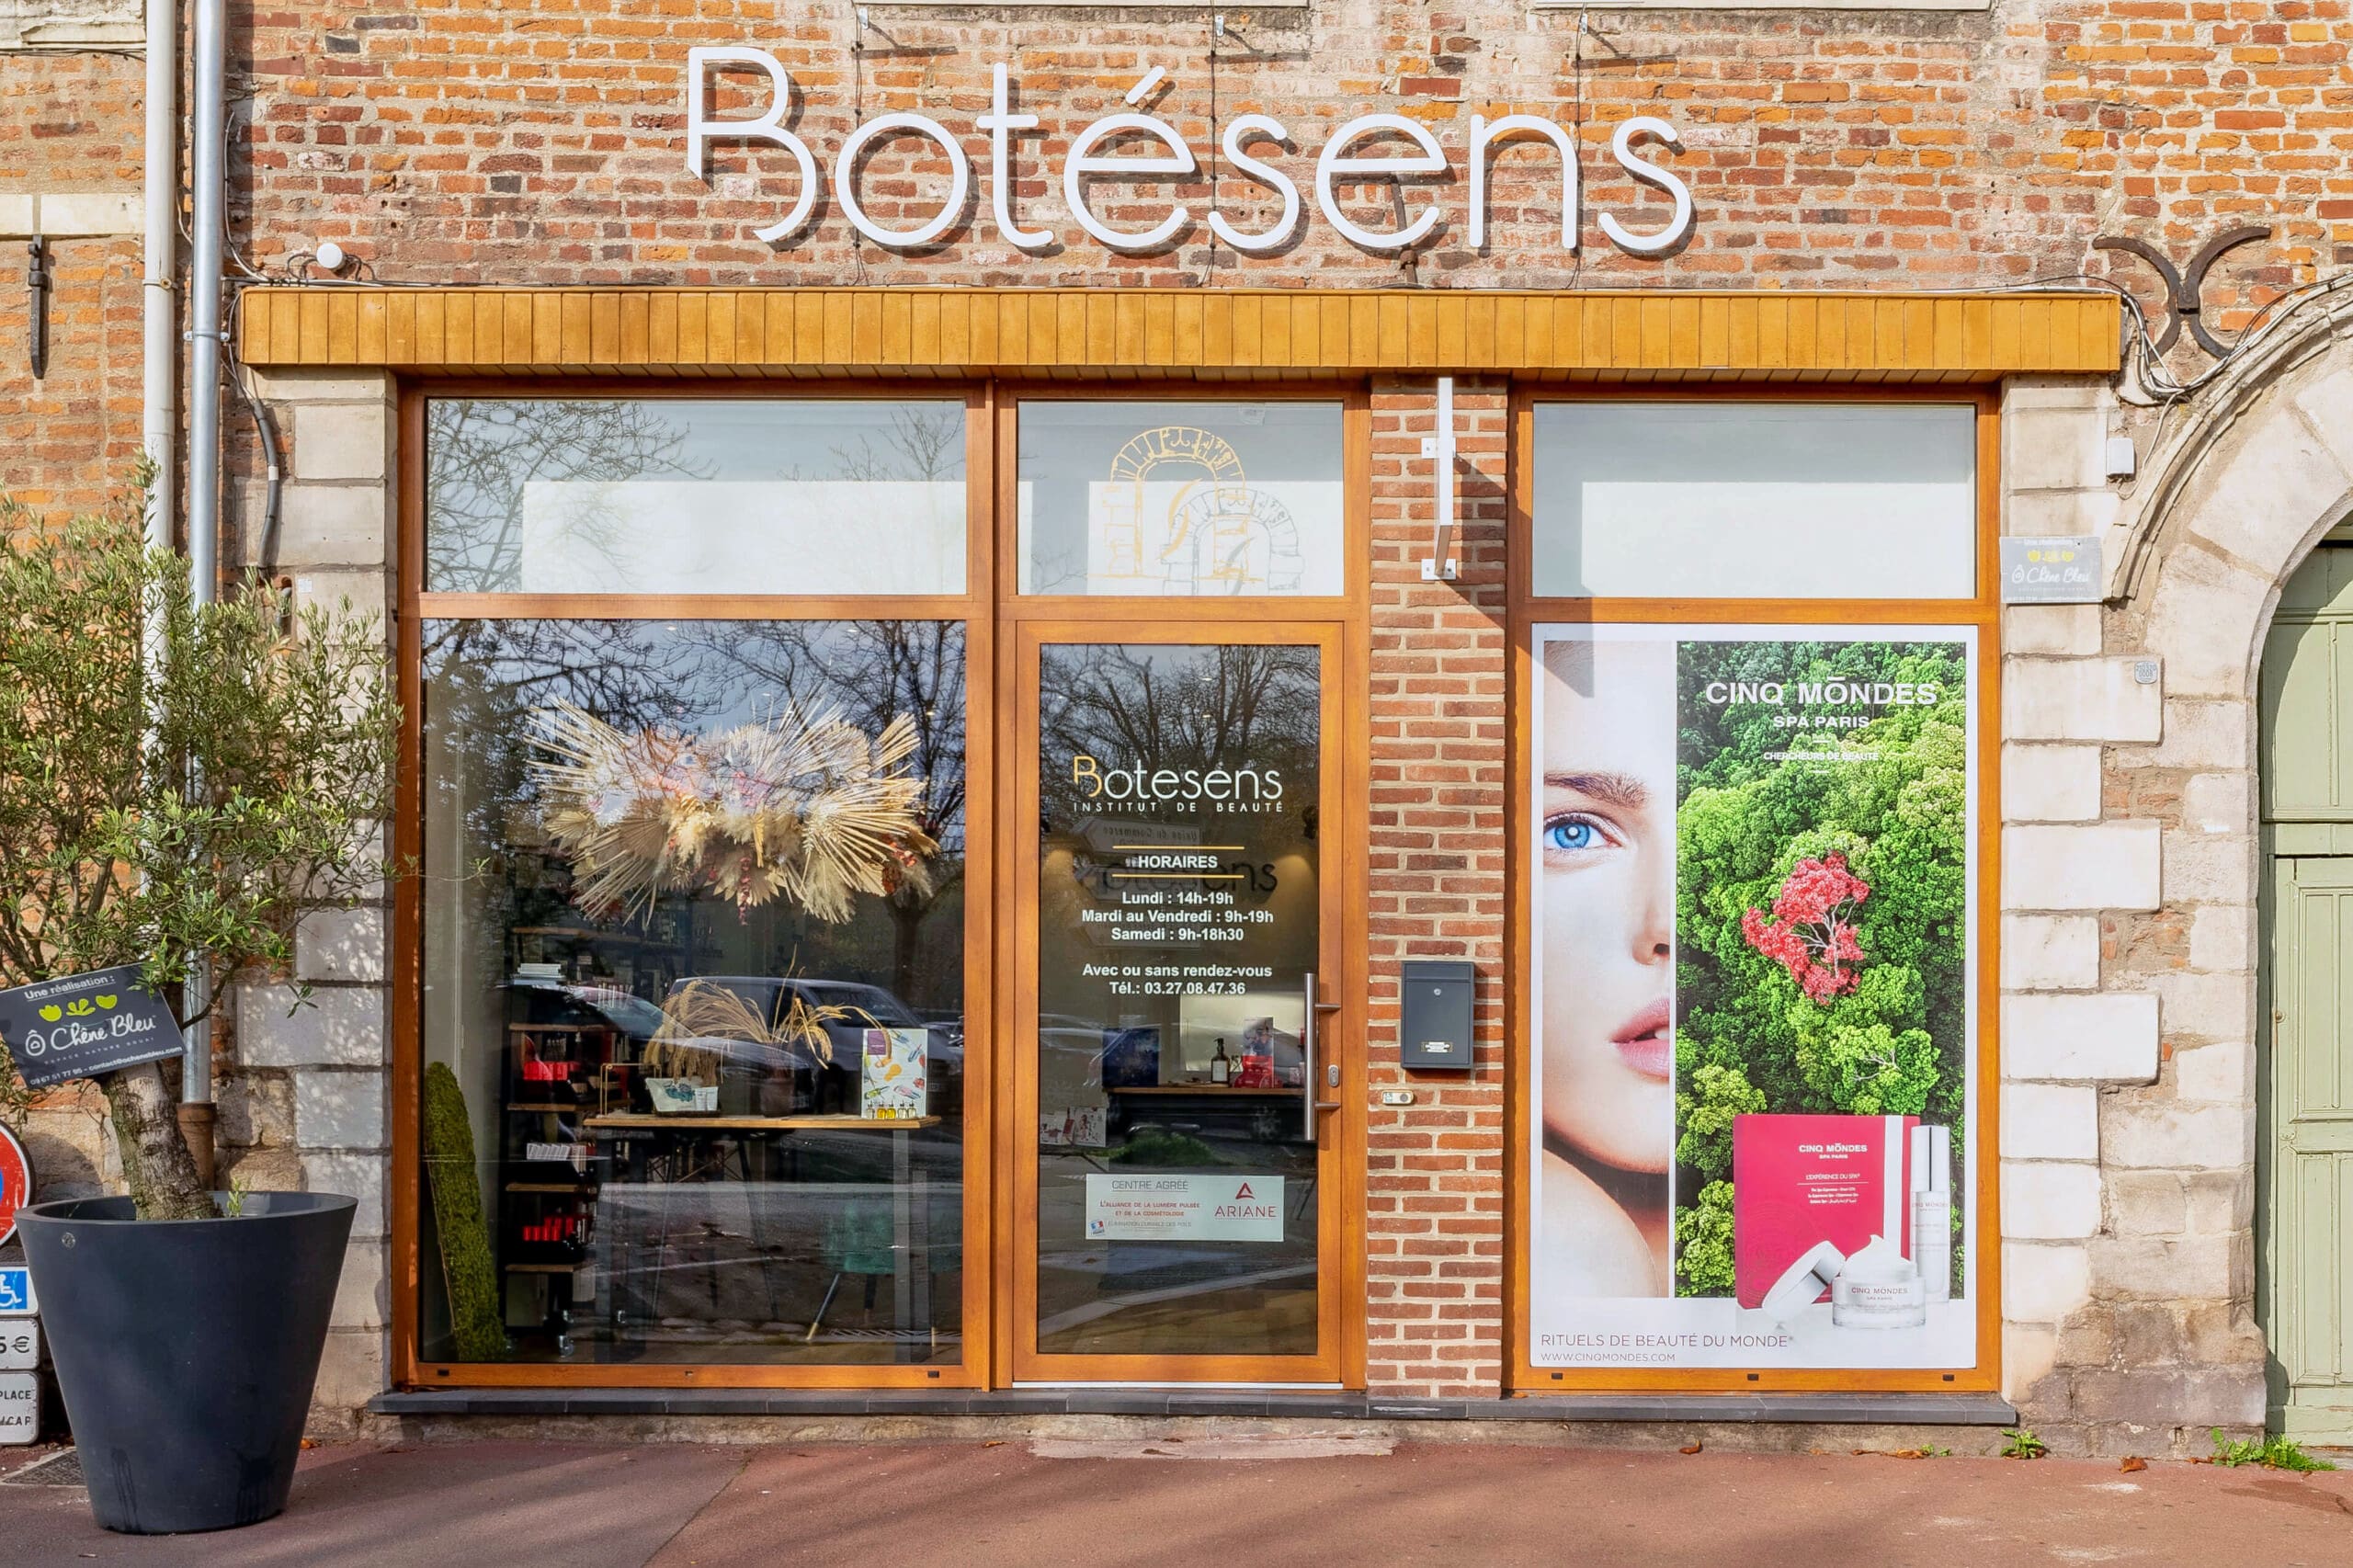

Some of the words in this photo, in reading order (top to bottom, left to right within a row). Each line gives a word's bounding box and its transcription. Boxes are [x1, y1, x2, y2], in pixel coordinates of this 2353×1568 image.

[688, 47, 1692, 251] Botésens
[1705, 681, 1784, 706] CINQ
[1773, 716, 1810, 728] SPA
[1814, 716, 1870, 728] PARIS
[1073, 756, 1283, 800] Botesens
[1074, 802, 1156, 812] INSTITUT
[1176, 802, 1197, 812] DE
[1216, 801, 1283, 812] BEAUTÉ
[1138, 855, 1219, 869] HORAIRES
[1122, 892, 1164, 904] Lundi
[1176, 892, 1233, 904] 14h-19h
[1081, 909, 1122, 923] Mardi
[1126, 913, 1143, 923] au
[1148, 909, 1211, 923] Vendredi
[1224, 910, 1274, 923] 9h-19h
[1111, 927, 1165, 940] Samedi
[1177, 927, 1245, 941] 9h-18h30
[1082, 963, 1119, 976] Avec
[1122, 967, 1141, 976] ou
[1144, 967, 1179, 976] sans
[1183, 964, 1273, 977] rendez-vous
[24, 989, 48, 1001] Une
[51, 976, 108, 994] réalisation
[1144, 982, 1246, 994] 03.27.08.47.36
[51, 1022, 108, 1051] Chêne
[106, 1013, 156, 1037] Bleu
[1799, 1144, 1824, 1153] CINQ
[1111, 1180, 1152, 1190] CENTRE
[1214, 1205, 1277, 1218] ARIANE
[1540, 1334, 1605, 1346] RITUELS
[1609, 1335, 1630, 1346] DE
[1635, 1332, 1698, 1347] BEAUTÉ
[1703, 1335, 1725, 1347] DU
[1540, 1353, 1676, 1362] WWW.CINQMONDES.COM
